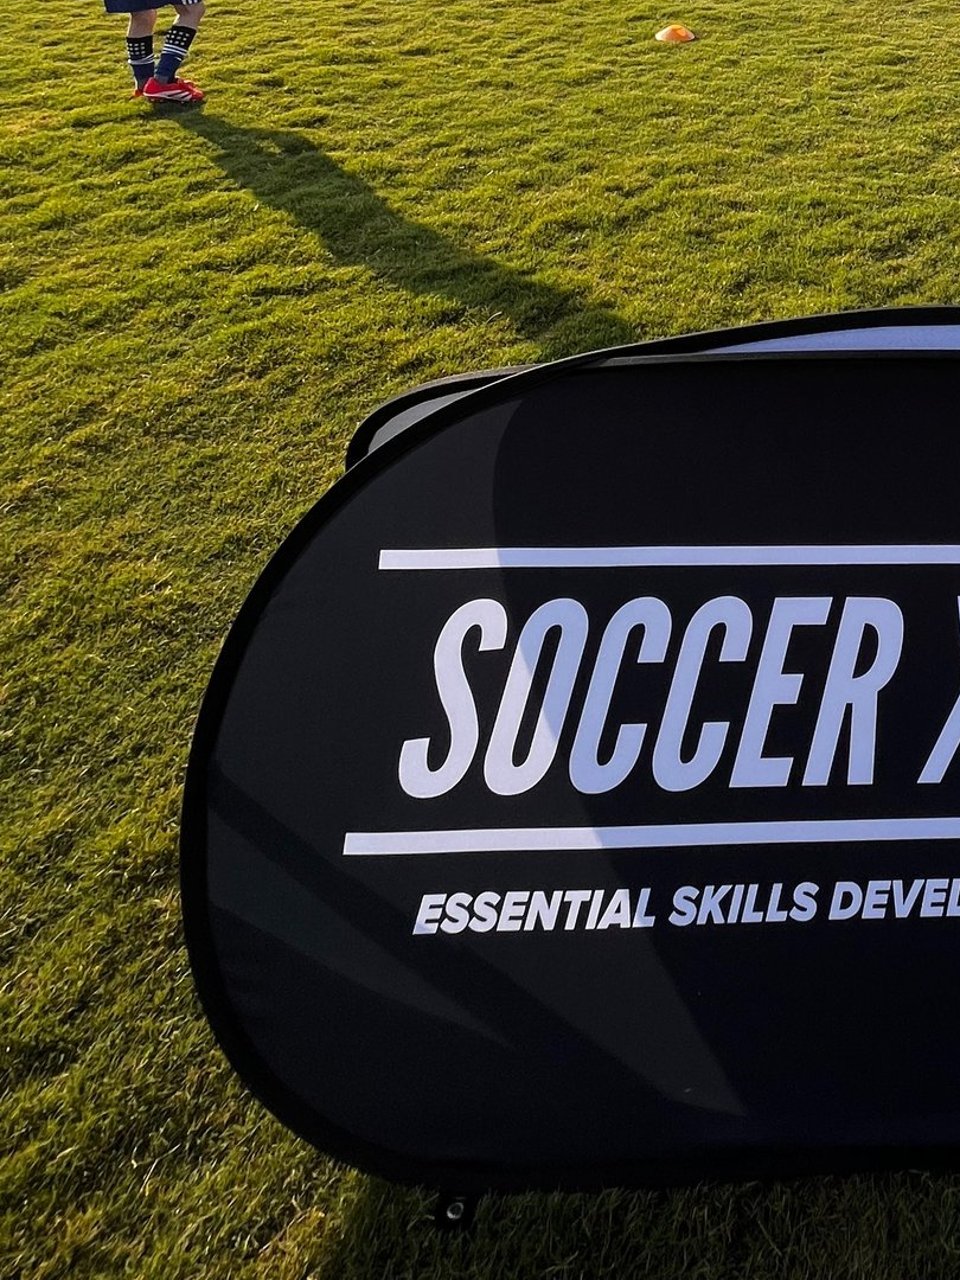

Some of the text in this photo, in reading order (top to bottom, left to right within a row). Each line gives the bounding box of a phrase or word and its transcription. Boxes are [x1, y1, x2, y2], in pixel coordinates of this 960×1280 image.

[398, 596, 904, 799] SOCCER
[412, 888, 655, 936] ESSENTIAL
[669, 882, 819, 927] SKILLS
